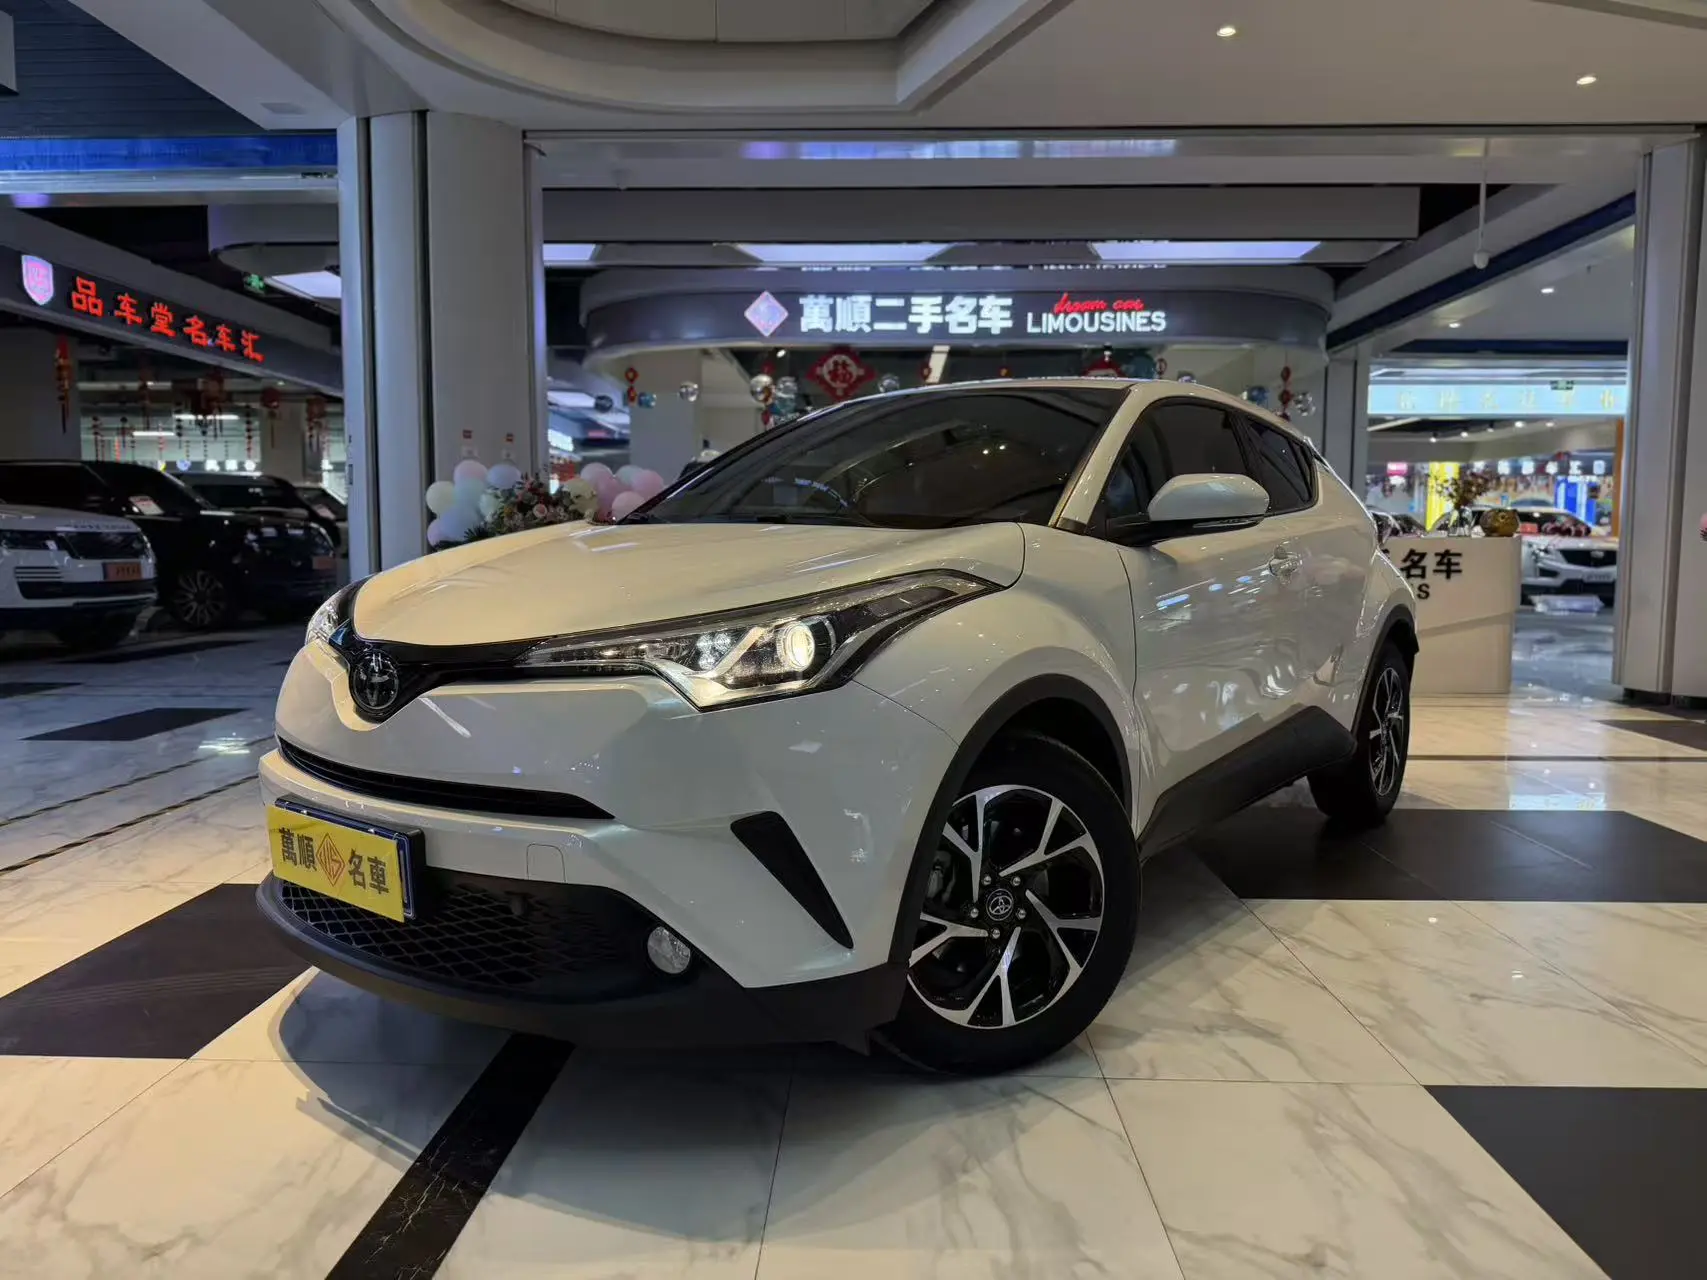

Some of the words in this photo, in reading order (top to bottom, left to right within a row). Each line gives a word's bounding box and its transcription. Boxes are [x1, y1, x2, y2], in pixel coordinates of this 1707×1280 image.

[71, 276, 265, 363] 品车堂名车汇
[799, 293, 1013, 334] 萬順二手名车
[1026, 310, 1167, 334] LIMOUSINES
[1382, 547, 1463, 580] 名车
[278, 826, 317, 872] 萬順
[348, 847, 390, 895] 名車
